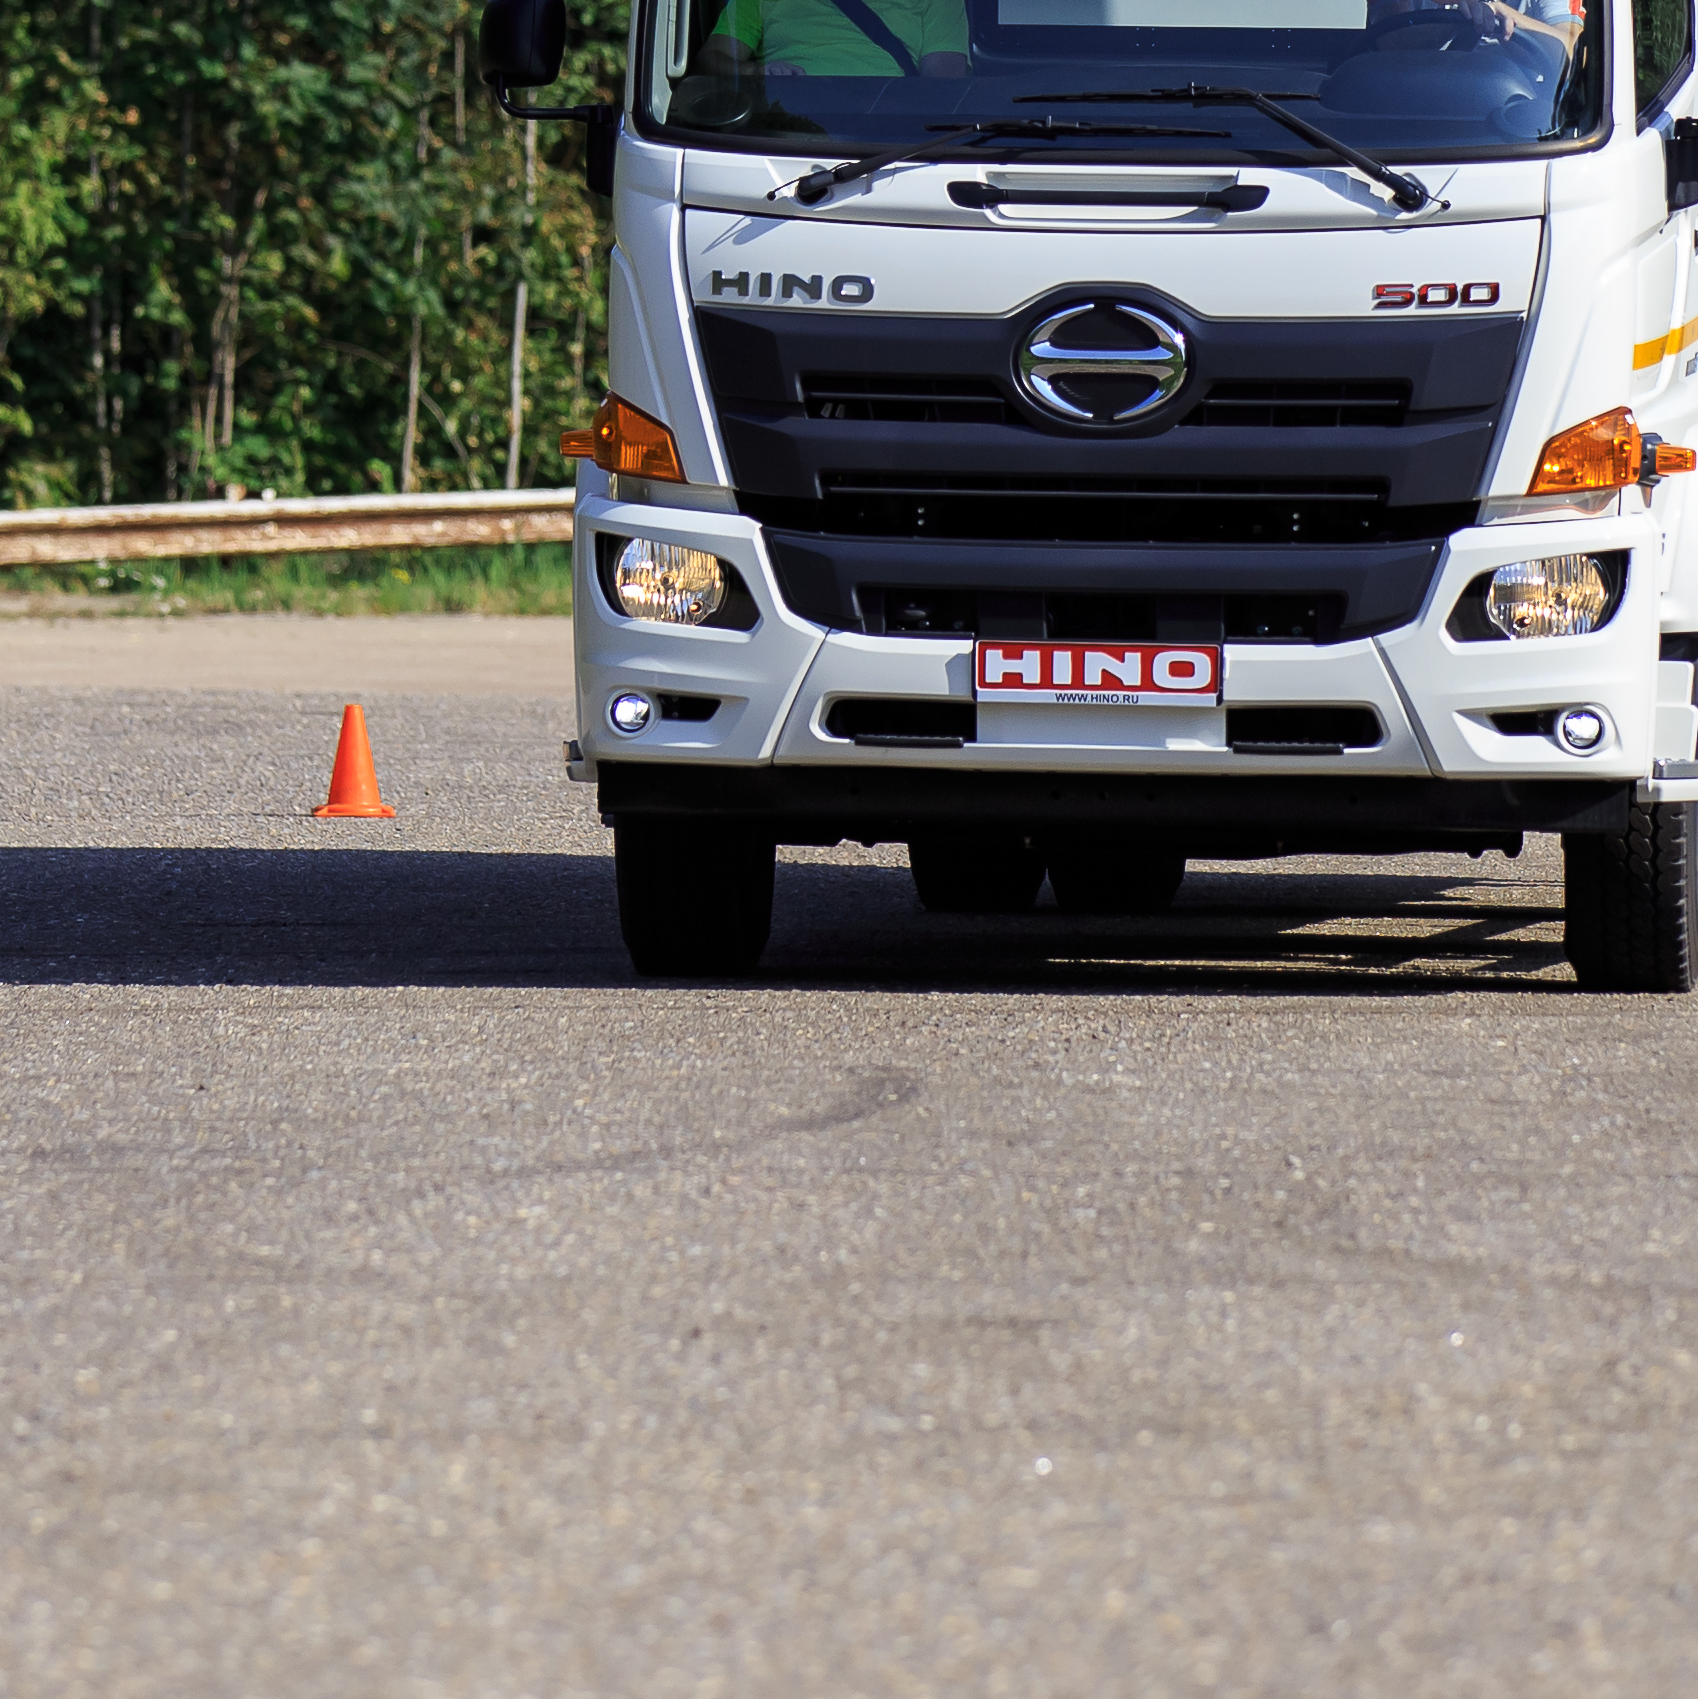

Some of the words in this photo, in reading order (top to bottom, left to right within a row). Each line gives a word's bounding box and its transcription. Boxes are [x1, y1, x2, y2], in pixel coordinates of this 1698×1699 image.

[712, 270, 874, 304] HINO
[1371, 282, 1500, 310] 500
[985, 649, 1211, 690] HINO
[1055, 693, 1139, 704] WWW.HINO.RU
